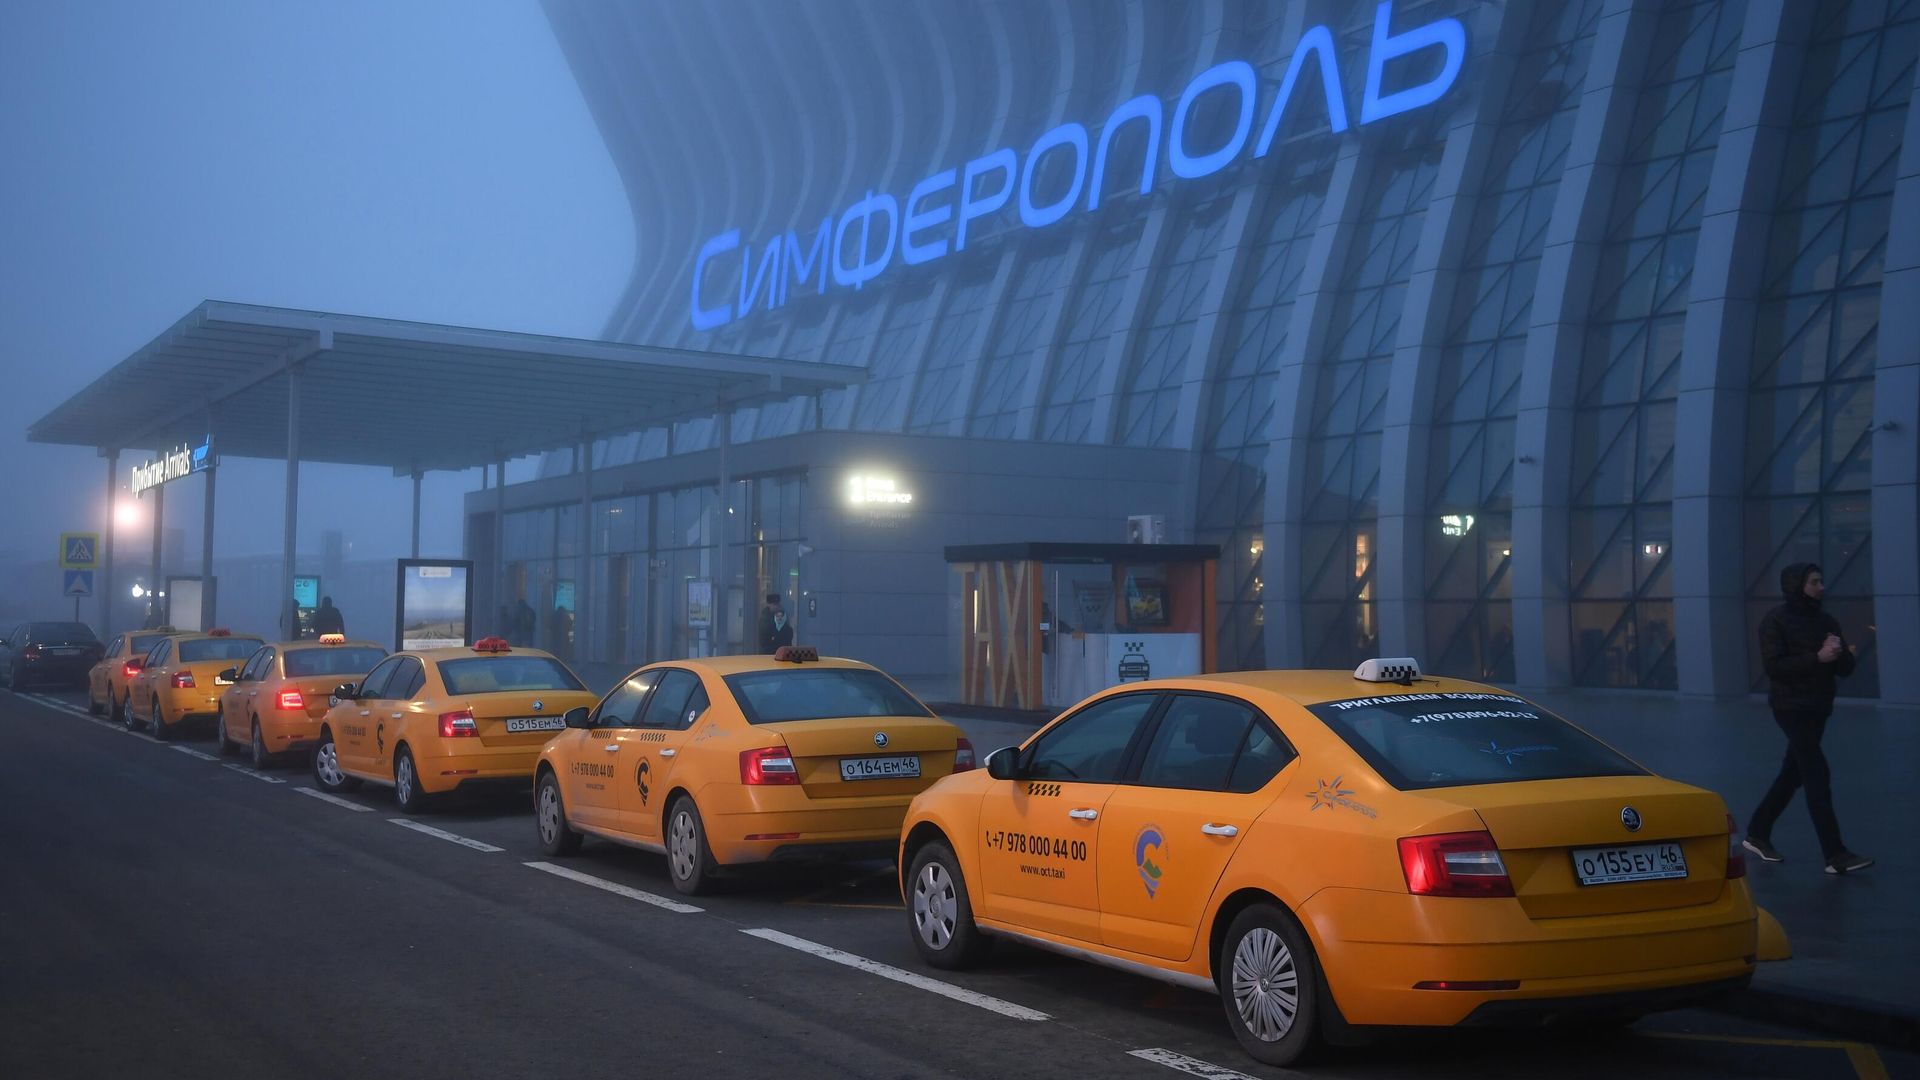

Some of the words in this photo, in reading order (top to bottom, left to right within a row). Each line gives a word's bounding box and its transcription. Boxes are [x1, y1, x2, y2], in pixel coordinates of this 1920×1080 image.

[131, 460, 164, 498] Прибытие
[165, 442, 190, 481] Arrivals
[902, 757, 915, 769] 46
[993, 831, 1004, 850] +7
[1007, 831, 1026, 853] 978
[1029, 836, 1050, 857] 000
[1053, 838, 1068, 859] 44
[1071, 840, 1087, 862] 00
[1660, 846, 1677, 863] 46
[1020, 863, 1066, 879] www.oct.taxi
